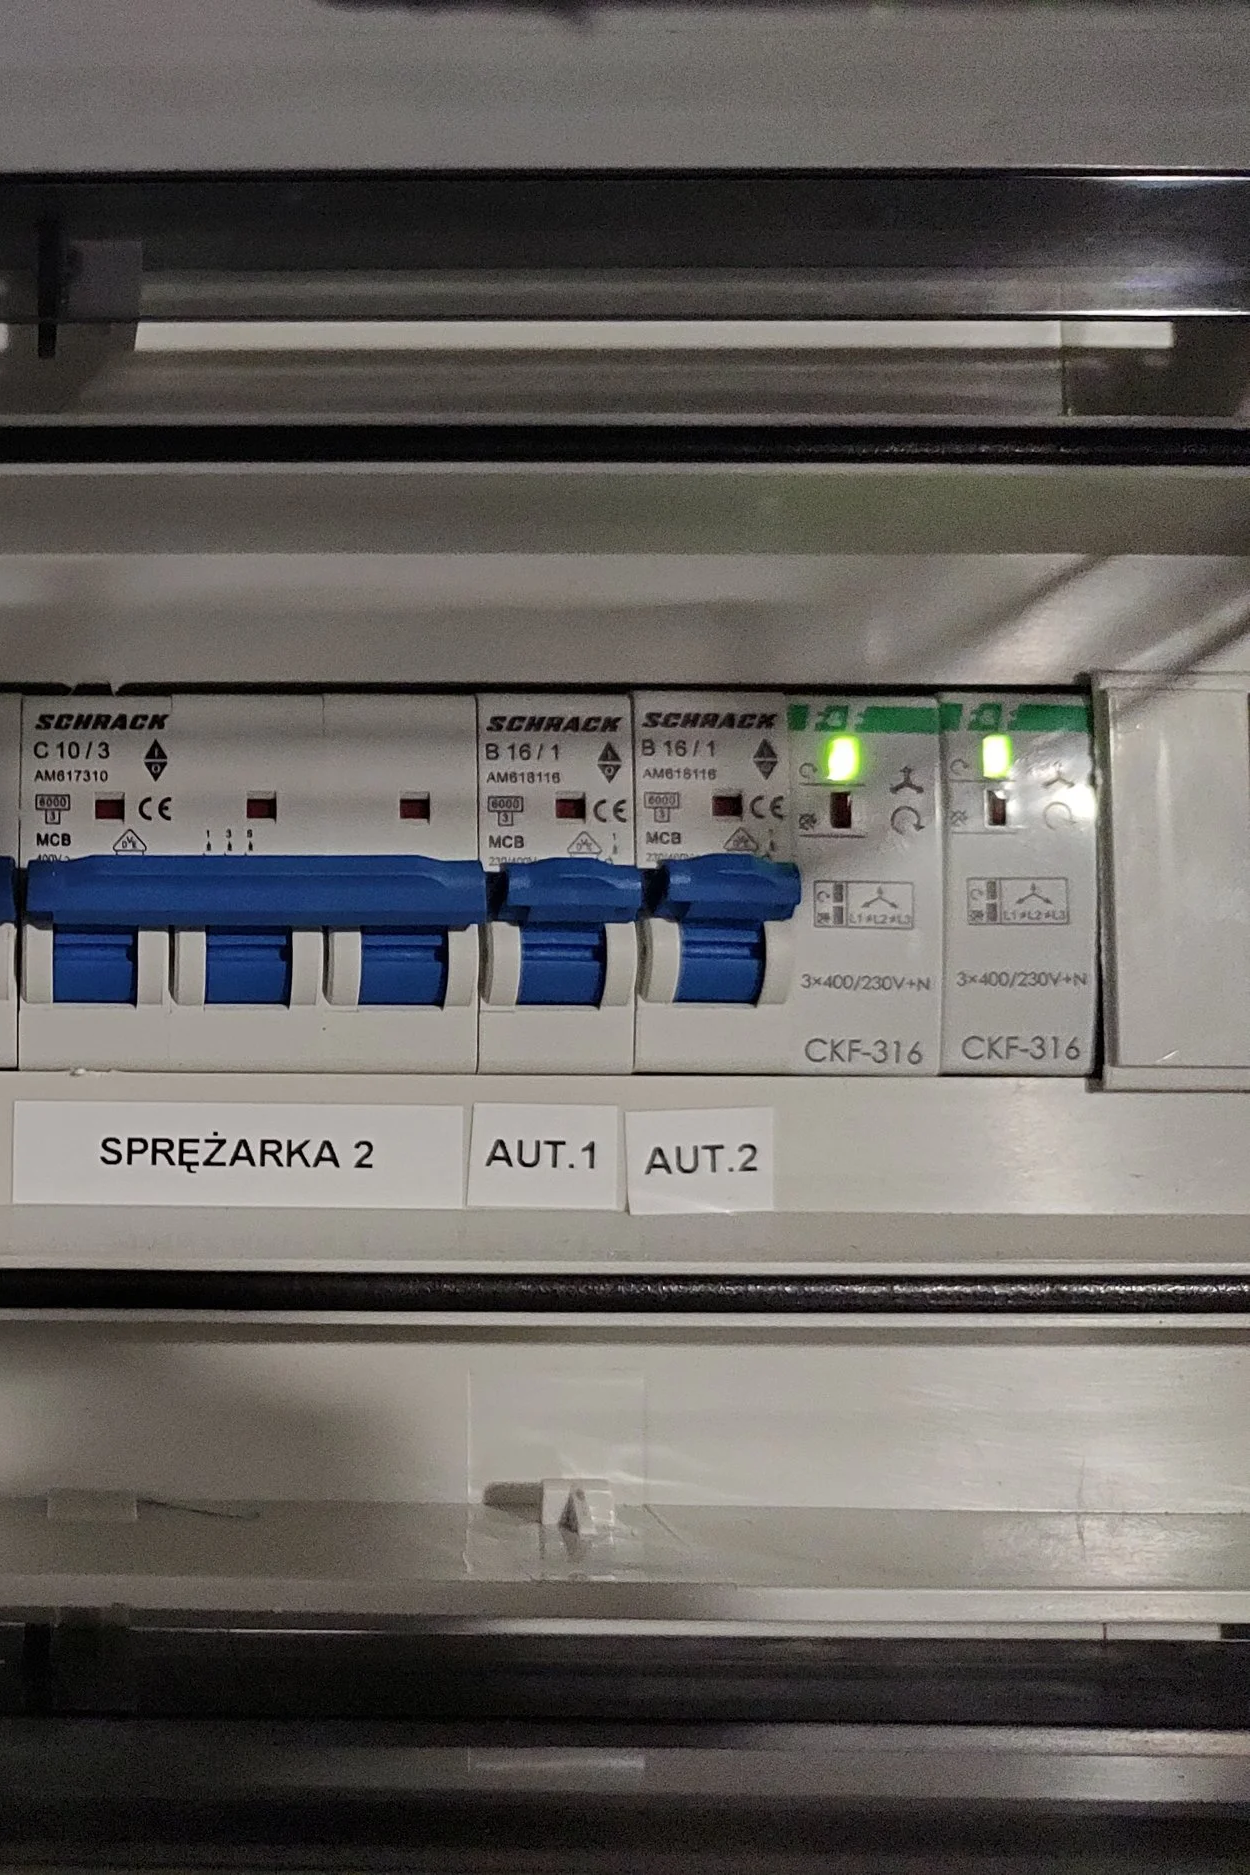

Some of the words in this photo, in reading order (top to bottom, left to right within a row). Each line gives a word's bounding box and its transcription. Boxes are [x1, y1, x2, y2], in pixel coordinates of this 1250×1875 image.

[34, 713, 170, 730] SCHRACK
[486, 716, 622, 732] SCHRACK
[642, 712, 778, 729] SCHRACK
[34, 769, 108, 782] AM617310
[138, 797, 172, 821] CE
[593, 799, 627, 823] CE
[751, 795, 784, 819] CE
[36, 833, 71, 846] MCB
[488, 835, 525, 848] MCB
[646, 832, 681, 845] MCB
[804, 1038, 924, 1065] CKF-316
[961, 1036, 1081, 1060] CKF-316
[100, 1131, 340, 1173] SPRĘŻARKA
[354, 1140, 374, 1169] 2
[485, 1138, 595, 1169] AUT.1
[644, 1143, 758, 1175] AUT.2
